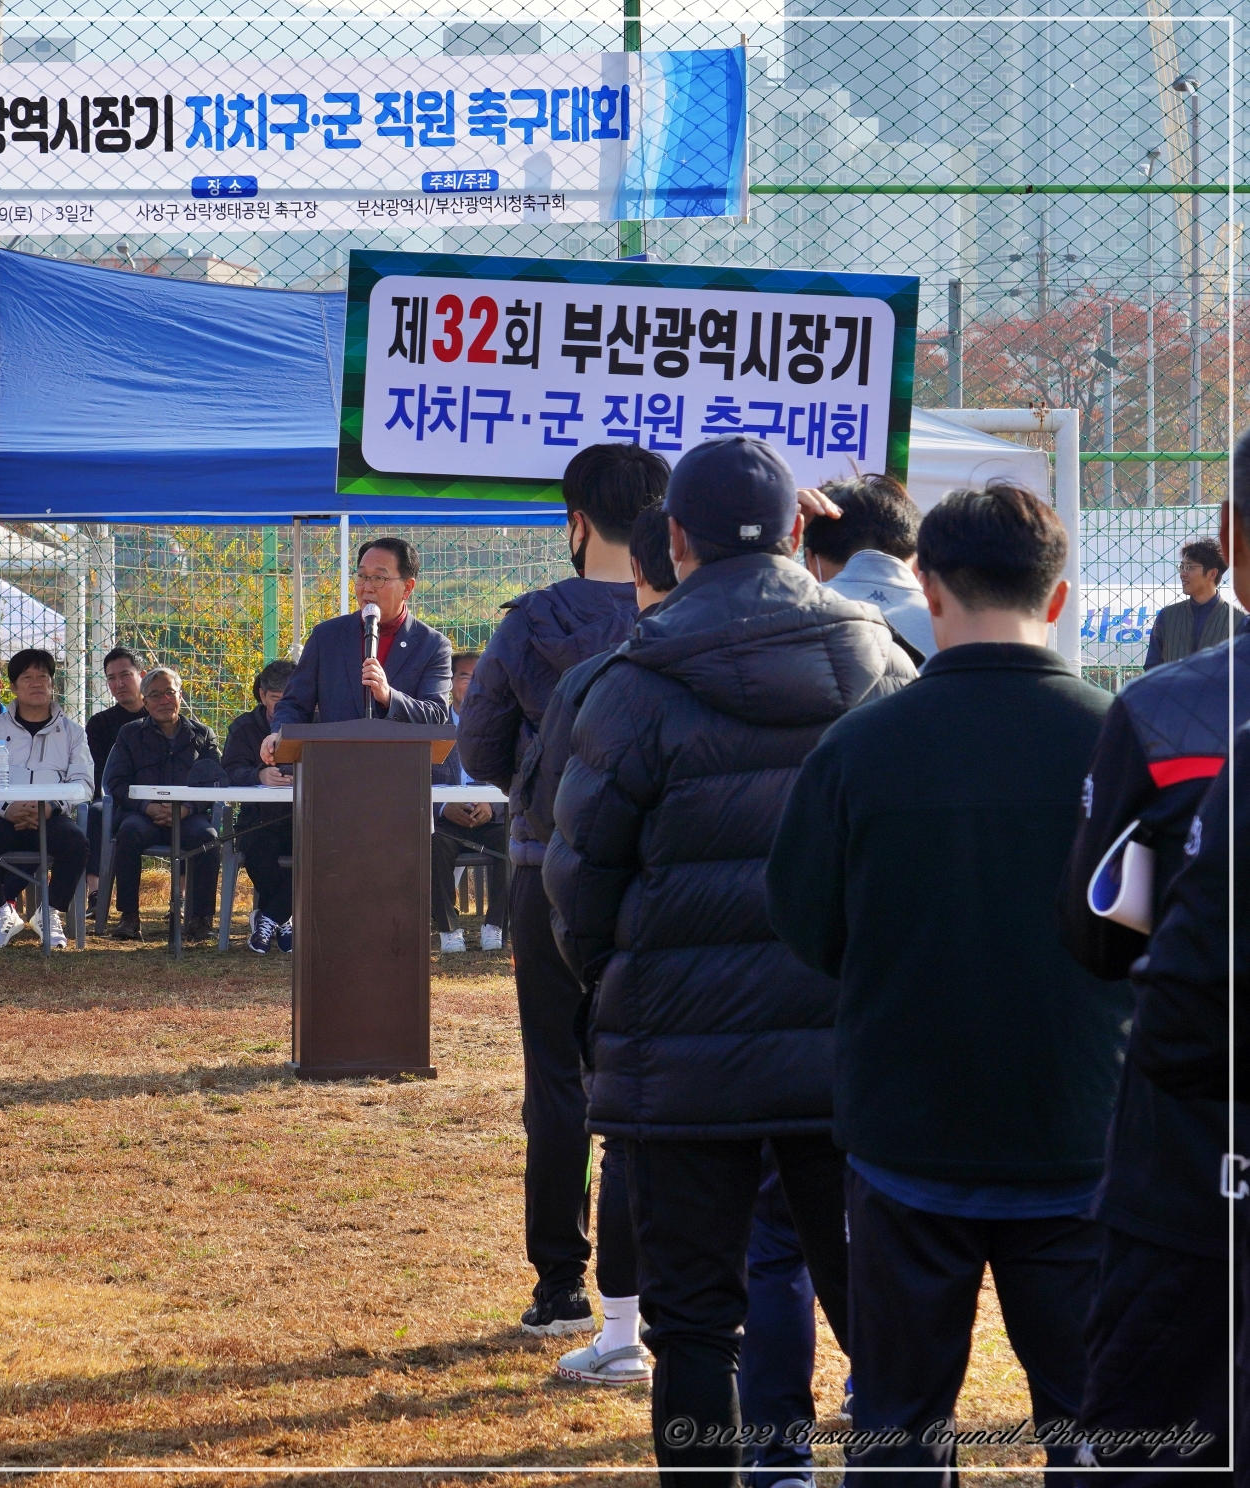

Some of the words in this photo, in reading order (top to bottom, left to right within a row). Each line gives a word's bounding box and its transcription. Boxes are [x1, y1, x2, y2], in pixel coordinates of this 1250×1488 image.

[375, 89, 455, 148] 직원
[467, 84, 631, 146] 축구대회
[429, 172, 492, 190] 주최/주관
[136, 203, 180, 221] 사상구
[183, 201, 270, 221] 삼락생태공원
[274, 200, 318, 219] 축구장
[356, 193, 565, 217] 부산광역시/부산광역시청축구회
[387, 293, 542, 370] 제32회
[561, 301, 872, 386] 부산광역시장기
[601, 391, 684, 451] 직원
